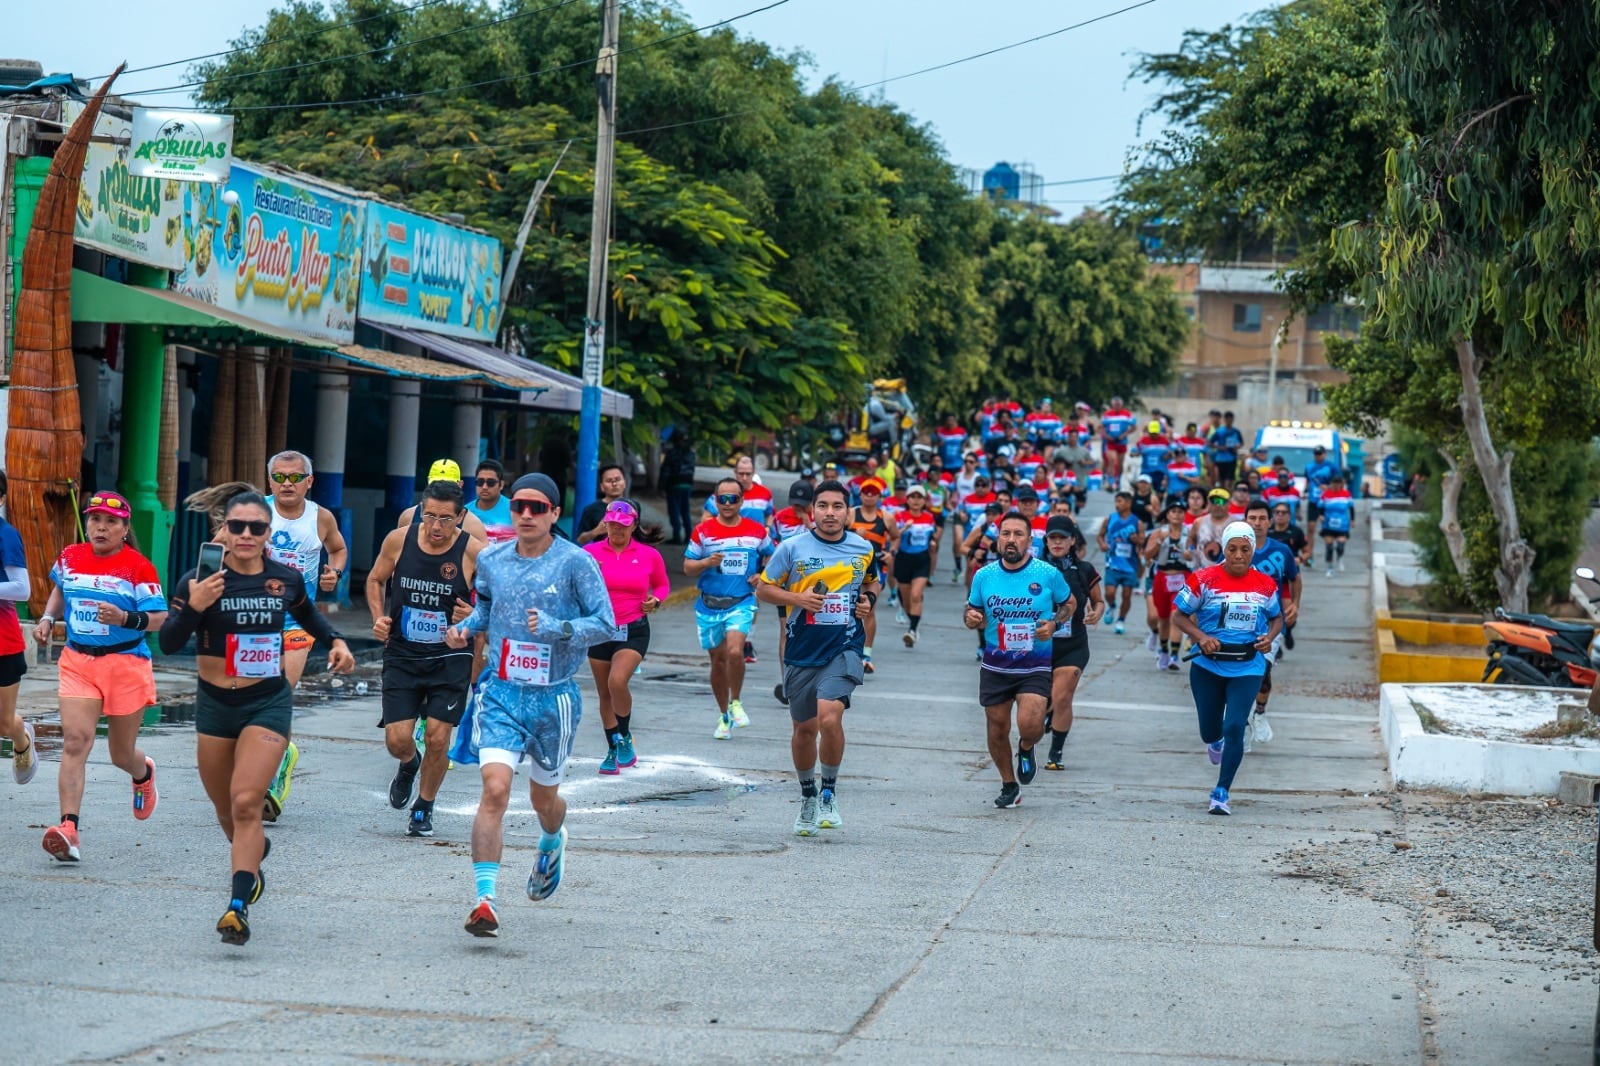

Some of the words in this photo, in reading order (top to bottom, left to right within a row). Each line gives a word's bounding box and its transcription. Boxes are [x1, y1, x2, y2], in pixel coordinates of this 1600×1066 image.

[254, 185, 297, 218] Restaurant
[238, 214, 291, 278] Punto
[291, 229, 330, 291] Mar
[401, 577, 453, 596] RUNNERS
[221, 597, 283, 611] RUNNERS
[411, 592, 440, 606] GYM
[819, 603, 841, 614] 155
[237, 612, 272, 624] GYM
[1228, 612, 1251, 621] 5026
[411, 620, 438, 633] 1039
[1007, 633, 1029, 641] 2154
[240, 650, 272, 662] 2206
[509, 655, 538, 669] 2169
